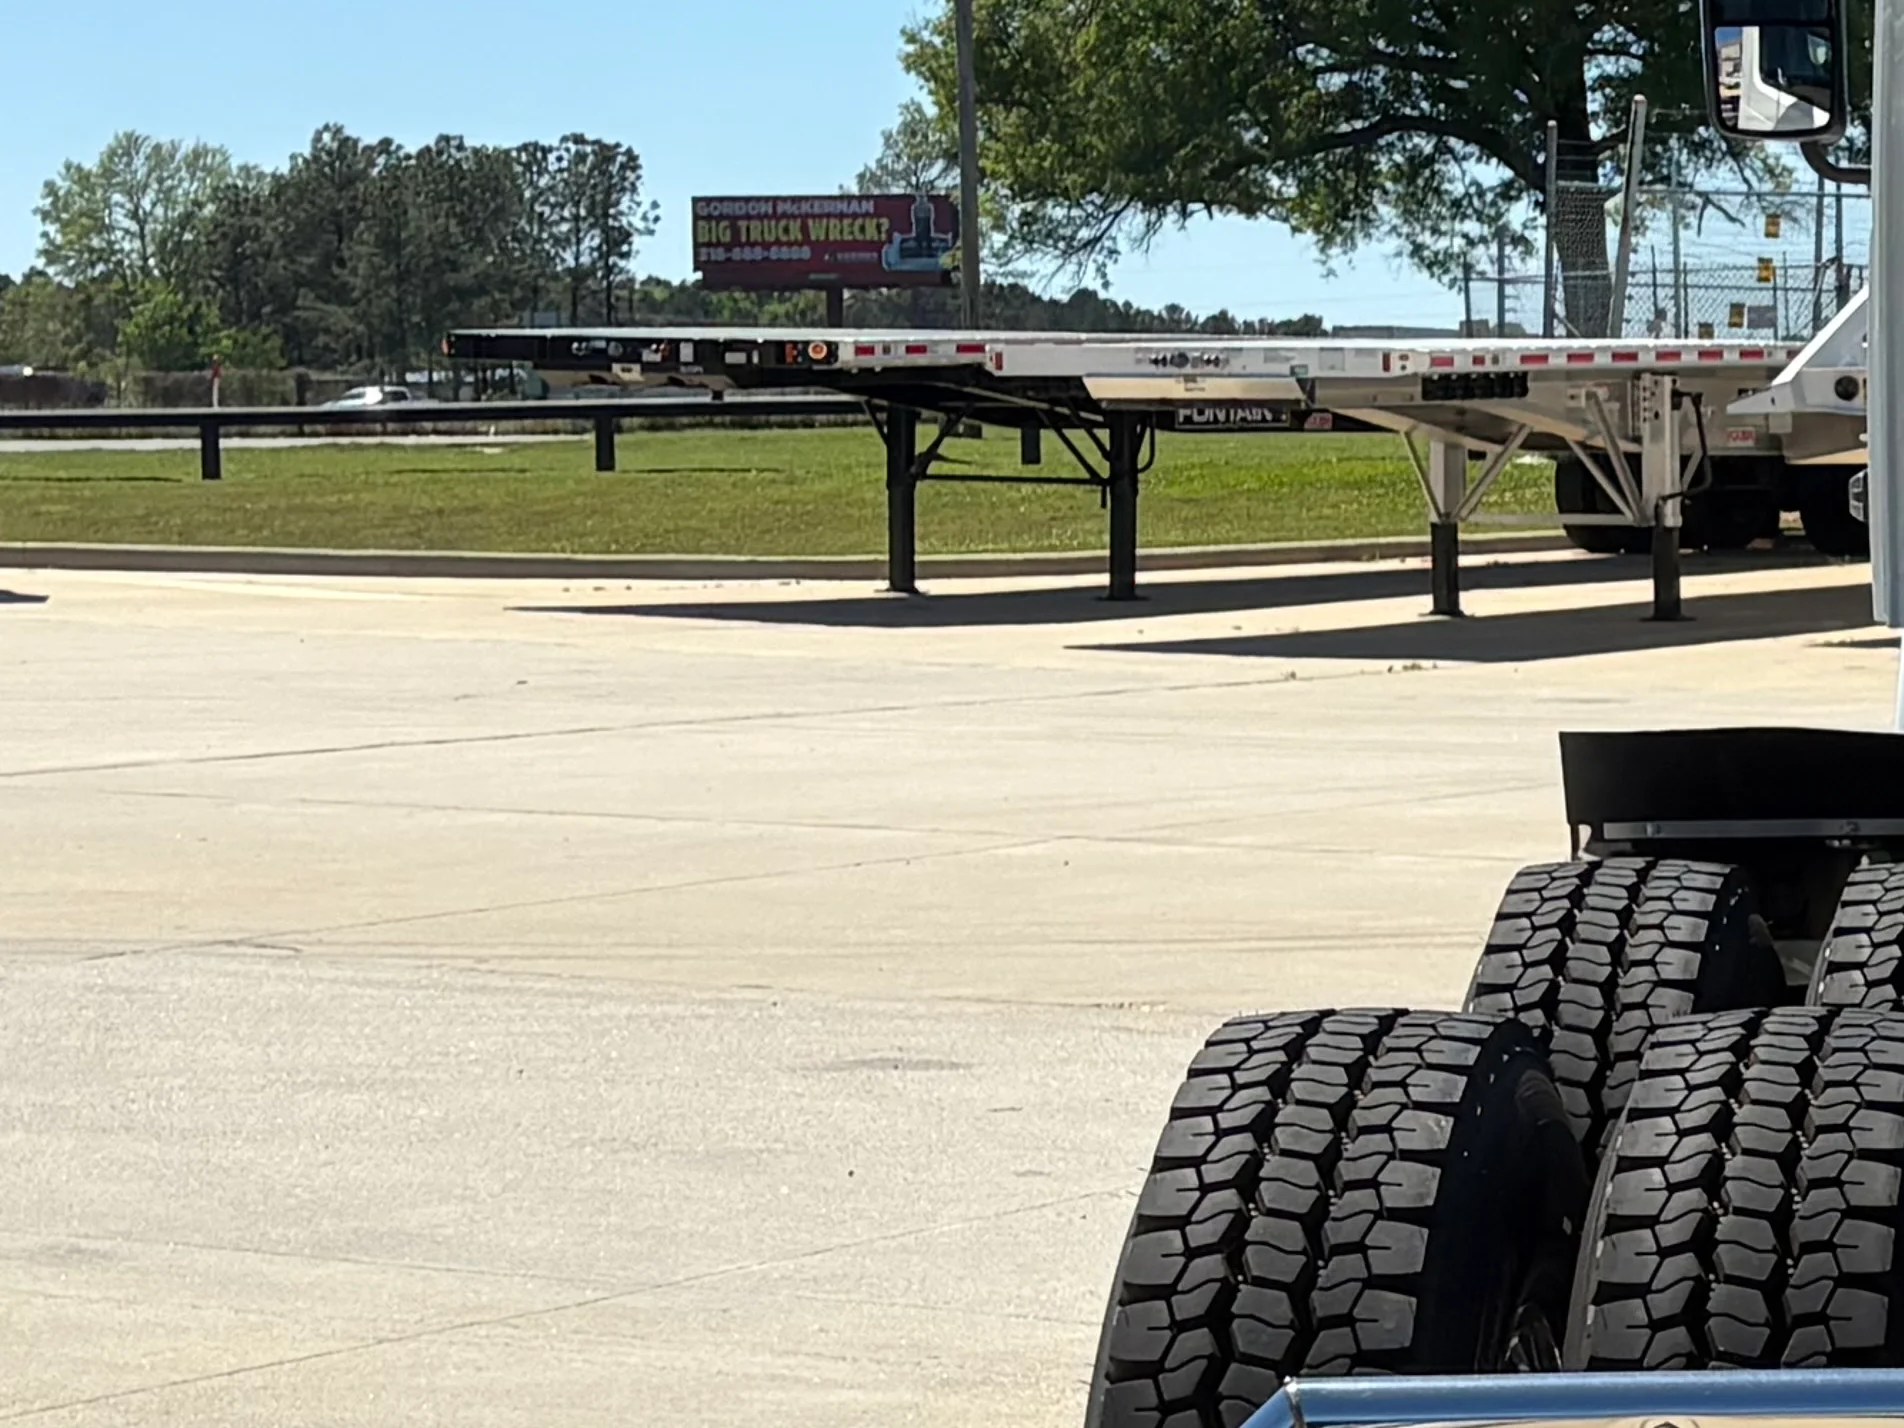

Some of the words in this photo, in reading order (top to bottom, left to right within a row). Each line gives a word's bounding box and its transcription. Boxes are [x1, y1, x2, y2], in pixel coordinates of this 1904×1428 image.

[697, 200, 774, 217] GORDON
[777, 199, 875, 215] McKERNAN
[696, 219, 732, 244] BIG
[737, 218, 803, 243] TRUCK
[809, 217, 890, 241] WRECK?
